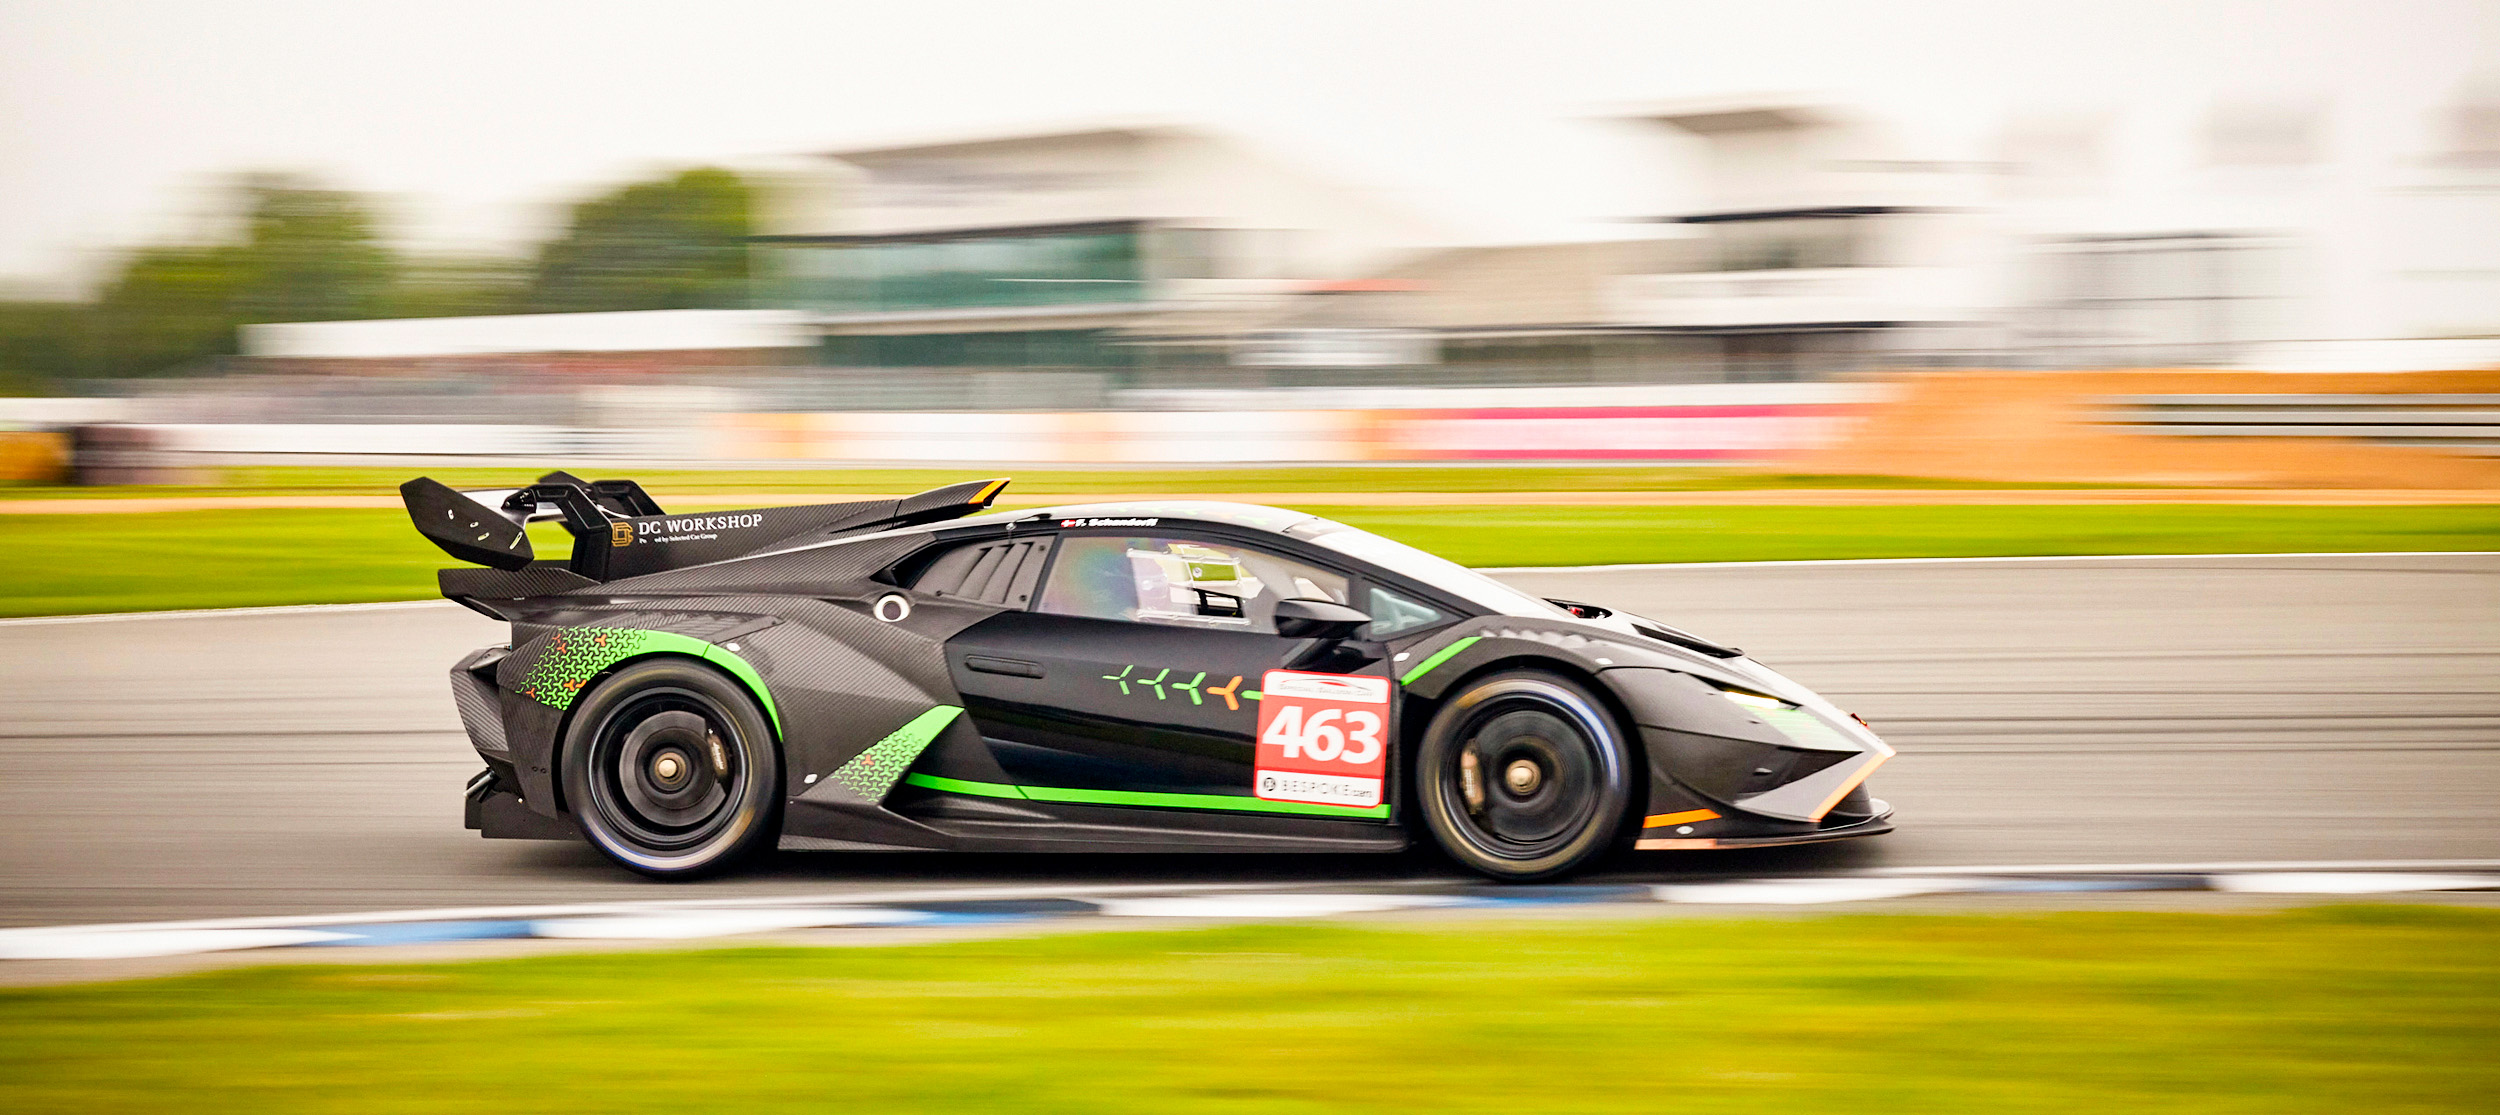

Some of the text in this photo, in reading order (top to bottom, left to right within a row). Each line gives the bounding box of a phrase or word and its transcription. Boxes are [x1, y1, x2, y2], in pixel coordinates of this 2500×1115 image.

[638, 514, 762, 535] DC WORKSHOP
[1262, 705, 1381, 764] 463
